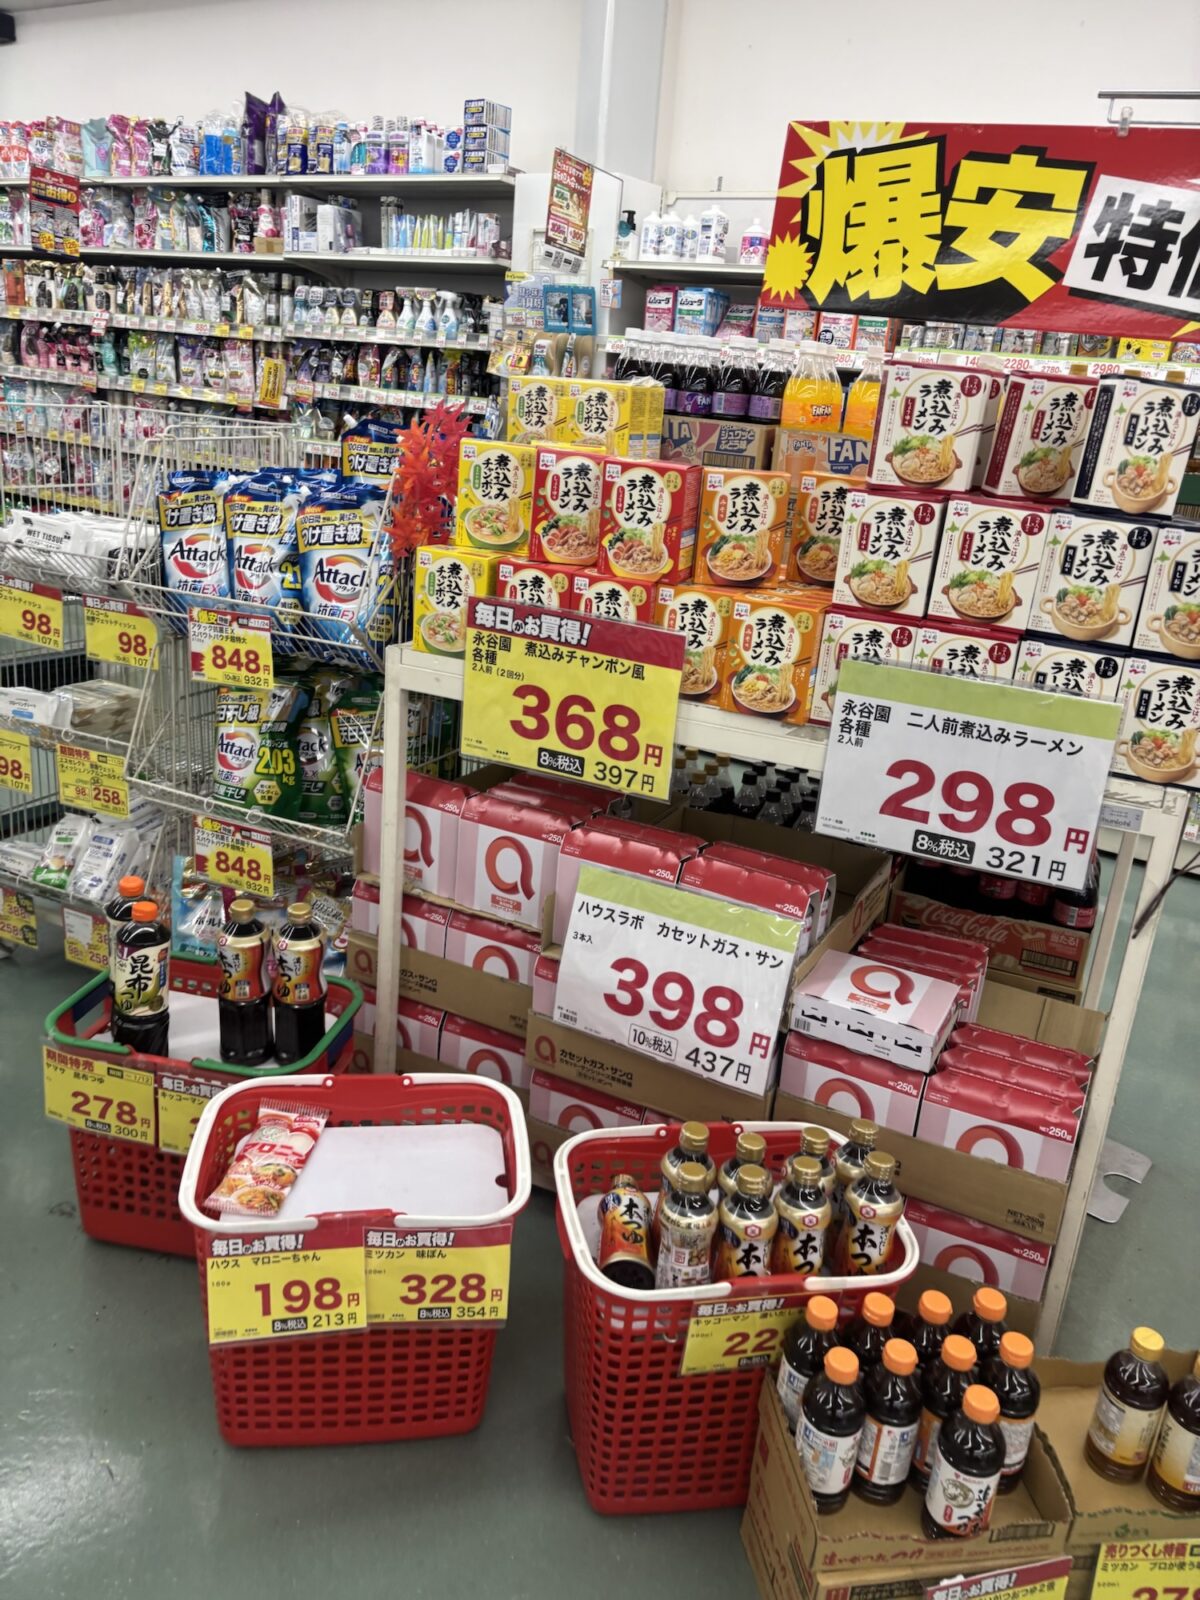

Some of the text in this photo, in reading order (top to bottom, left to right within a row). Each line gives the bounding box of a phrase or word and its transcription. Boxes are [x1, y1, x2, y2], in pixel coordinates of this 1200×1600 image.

[805, 142, 1089, 306] 爆安
[534, 385, 548, 428] 煮込み
[594, 392, 608, 433] 煮込み
[913, 385, 932, 430] ラーメン
[929, 379, 953, 435] 煮込み
[1040, 398, 1060, 443] ラーメン
[1052, 392, 1078, 447] 煮込み
[1134, 401, 1155, 450] ラーメン
[1148, 396, 1175, 455] 煮込み
[828, 437, 870, 464] FAN
[493, 454, 511, 502] 煮込み
[572, 463, 592, 513] 煮込み
[637, 474, 656, 527] 煮込み
[740, 482, 760, 533] 煮込み
[27, 529, 63, 544] WET TISSUE
[167, 538, 228, 562] Attack
[869, 511, 887, 555] ラーメン
[883, 507, 908, 561] 煮込み
[971, 521, 993, 566] ラーメン
[987, 516, 1014, 573] 煮込み
[235, 544, 277, 573] Attack
[1073, 534, 1095, 580] ラーメン
[1089, 529, 1119, 586] 煮込み
[447, 562, 463, 609] 煮込み
[529, 575, 545, 606] 煮込
[604, 588, 622, 620] 煮込
[22, 609, 61, 638] 98円
[688, 599, 708, 649] 煮込み
[765, 614, 787, 666] 煮込み
[212, 644, 271, 675] 848円
[472, 631, 645, 681] 永谷園 煮込みチャンポン風
[472, 649, 498, 666] 各種
[864, 629, 884, 664] 煮込
[958, 645, 981, 678] 煮込
[244, 675, 270, 687] 932円
[1062, 658, 1087, 692] 煮込
[1149, 679, 1170, 723] ラーメン
[1166, 675, 1196, 730] 煮込み
[218, 732, 256, 759] Attack
[837, 734, 864, 748] 2人前
[838, 717, 871, 738] 各種
[841, 699, 1084, 757] 永谷園 二人前煮込みラーメン
[593, 761, 655, 793] 397円
[215, 850, 271, 884] 848円
[915, 833, 1066, 882] 8%税込 321円
[572, 930, 594, 945] 3本入
[577, 901, 784, 970] ハウスラボ カセットガス・サン
[922, 903, 1009, 943] Coca-Cola
[46, 1049, 94, 1072] 期間特売
[46, 1062, 105, 1084] ヤマサ 昆布つゆ
[685, 1047, 753, 1085] 437円
[71, 1090, 151, 1128] 278円
[115, 1125, 148, 1140] 300円
[620, 1197, 644, 1245] 本つゆ
[211, 1251, 321, 1269] ハウス マロニーちゃん
[365, 1249, 405, 1259] ミツカン
[793, 1232, 818, 1275] 本つ
[851, 1223, 878, 1274] 本つ
[255, 1277, 360, 1317] 198円
[399, 1273, 503, 1305] 328円
[312, 1312, 358, 1329] 213円
[456, 1306, 499, 1318] 354円
[722, 1328, 783, 1358] 22
[1100, 1561, 1138, 1572] ミツカン
